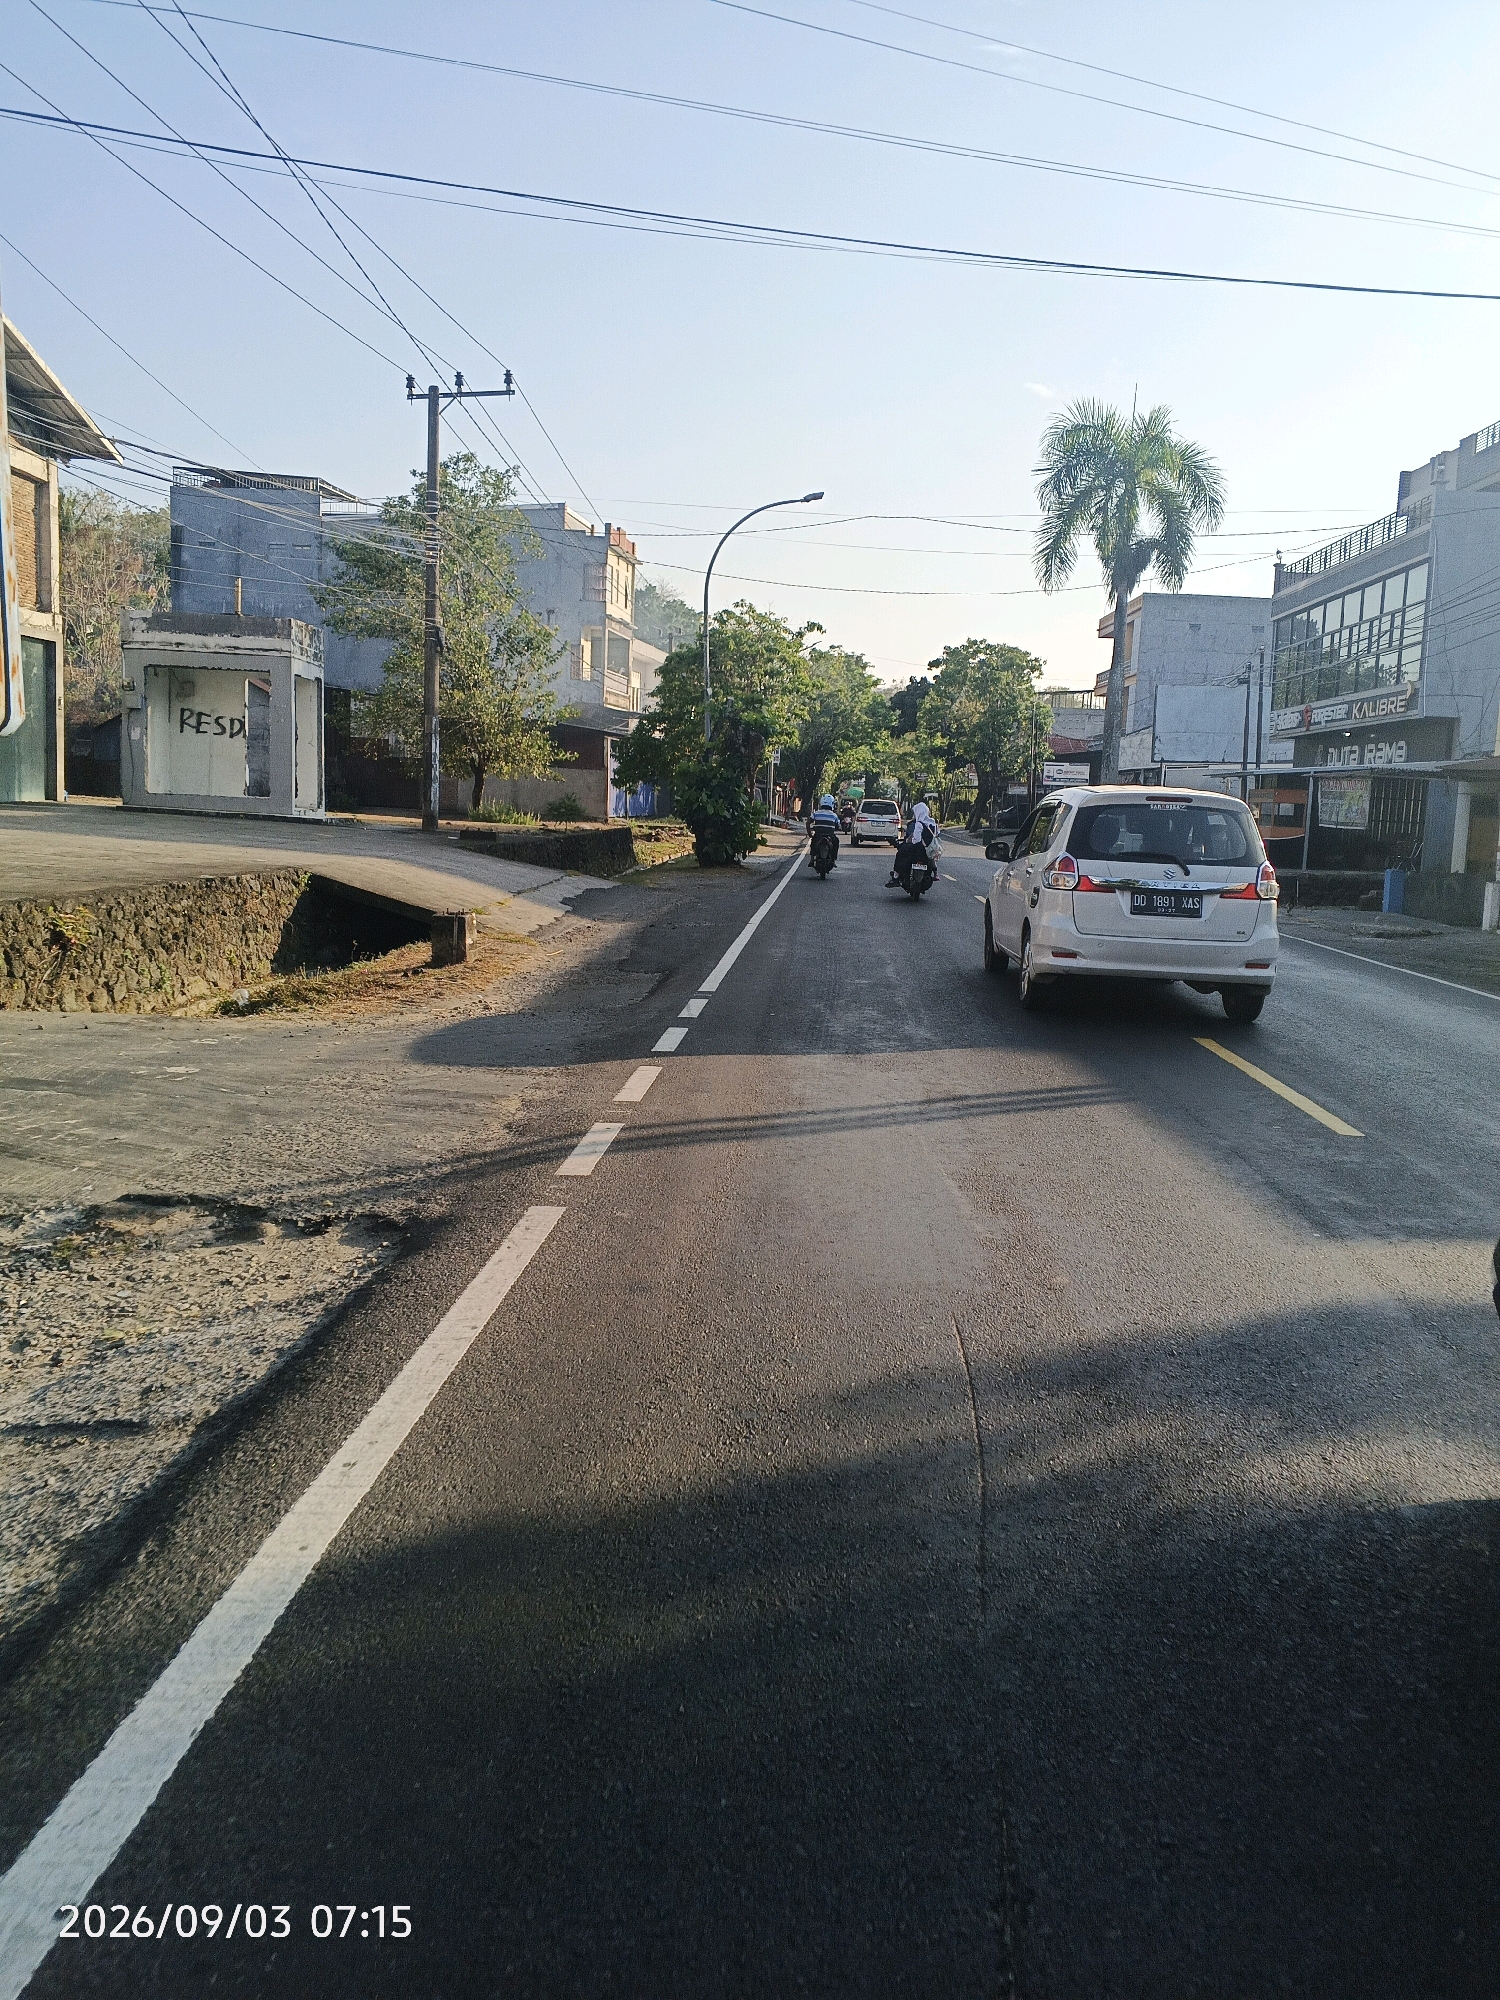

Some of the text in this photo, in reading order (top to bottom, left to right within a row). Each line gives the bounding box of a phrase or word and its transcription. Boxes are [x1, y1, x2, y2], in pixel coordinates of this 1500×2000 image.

[1352, 694, 1406, 720] KALIBRE
[1134, 894, 1200, 909] DD 1891 XAS
